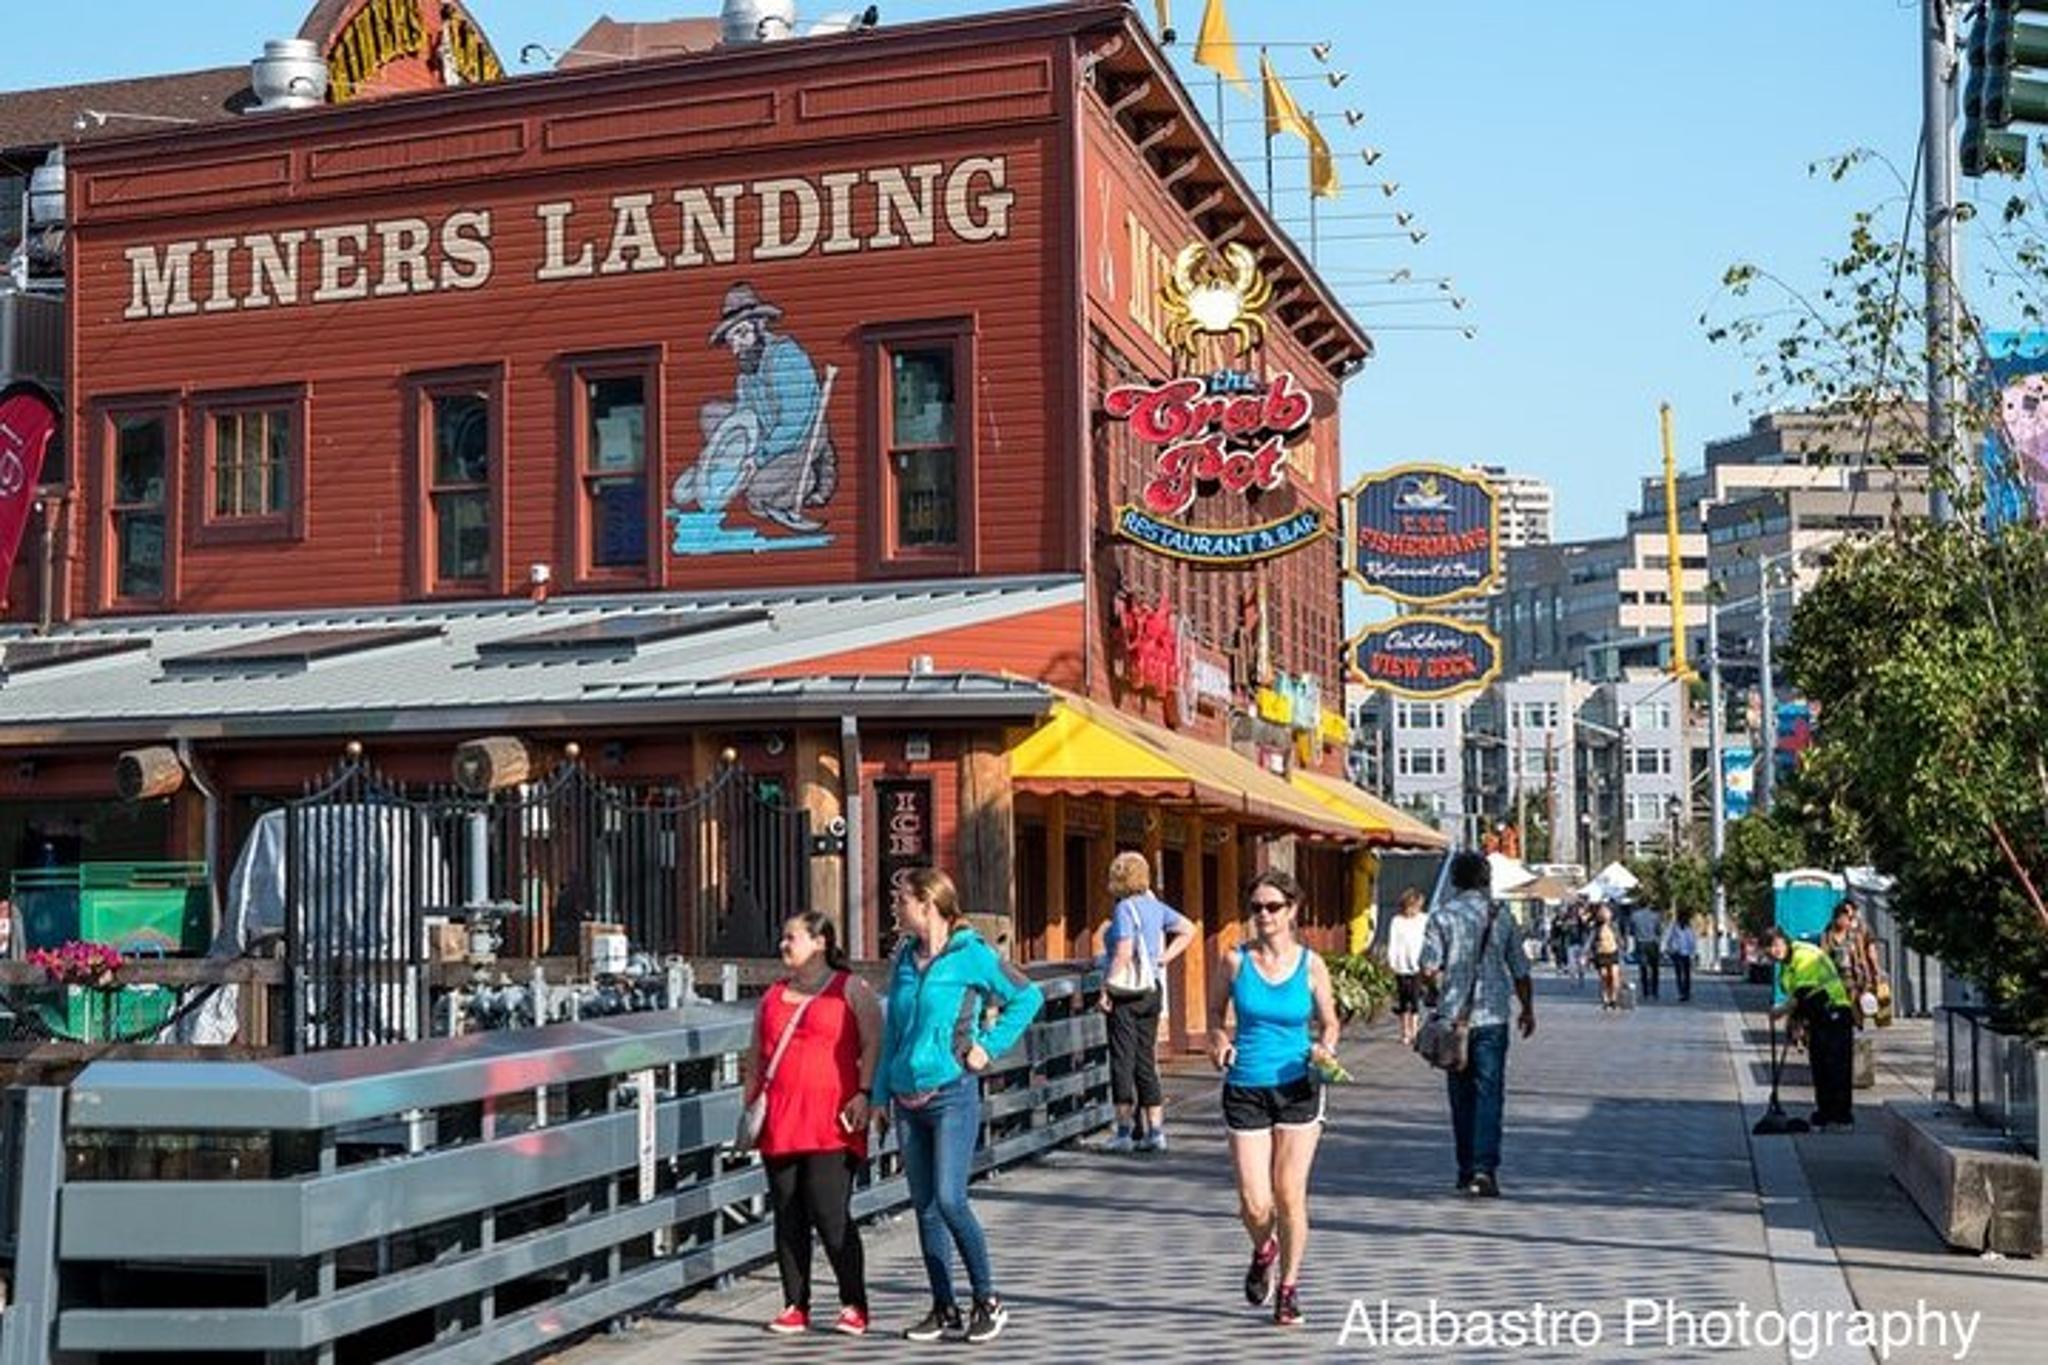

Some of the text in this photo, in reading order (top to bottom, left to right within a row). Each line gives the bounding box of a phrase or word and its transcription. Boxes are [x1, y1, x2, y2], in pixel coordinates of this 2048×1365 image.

[124, 155, 1014, 319] MINERS LANDING
[1104, 373, 1312, 442] Crab
[1211, 369, 1256, 391] the
[1144, 433, 1287, 514] Pot
[1123, 511, 1318, 555] RESTAURANT & BAR
[1370, 652, 1422, 679] VIEW
[889, 792, 922, 854] ICE
